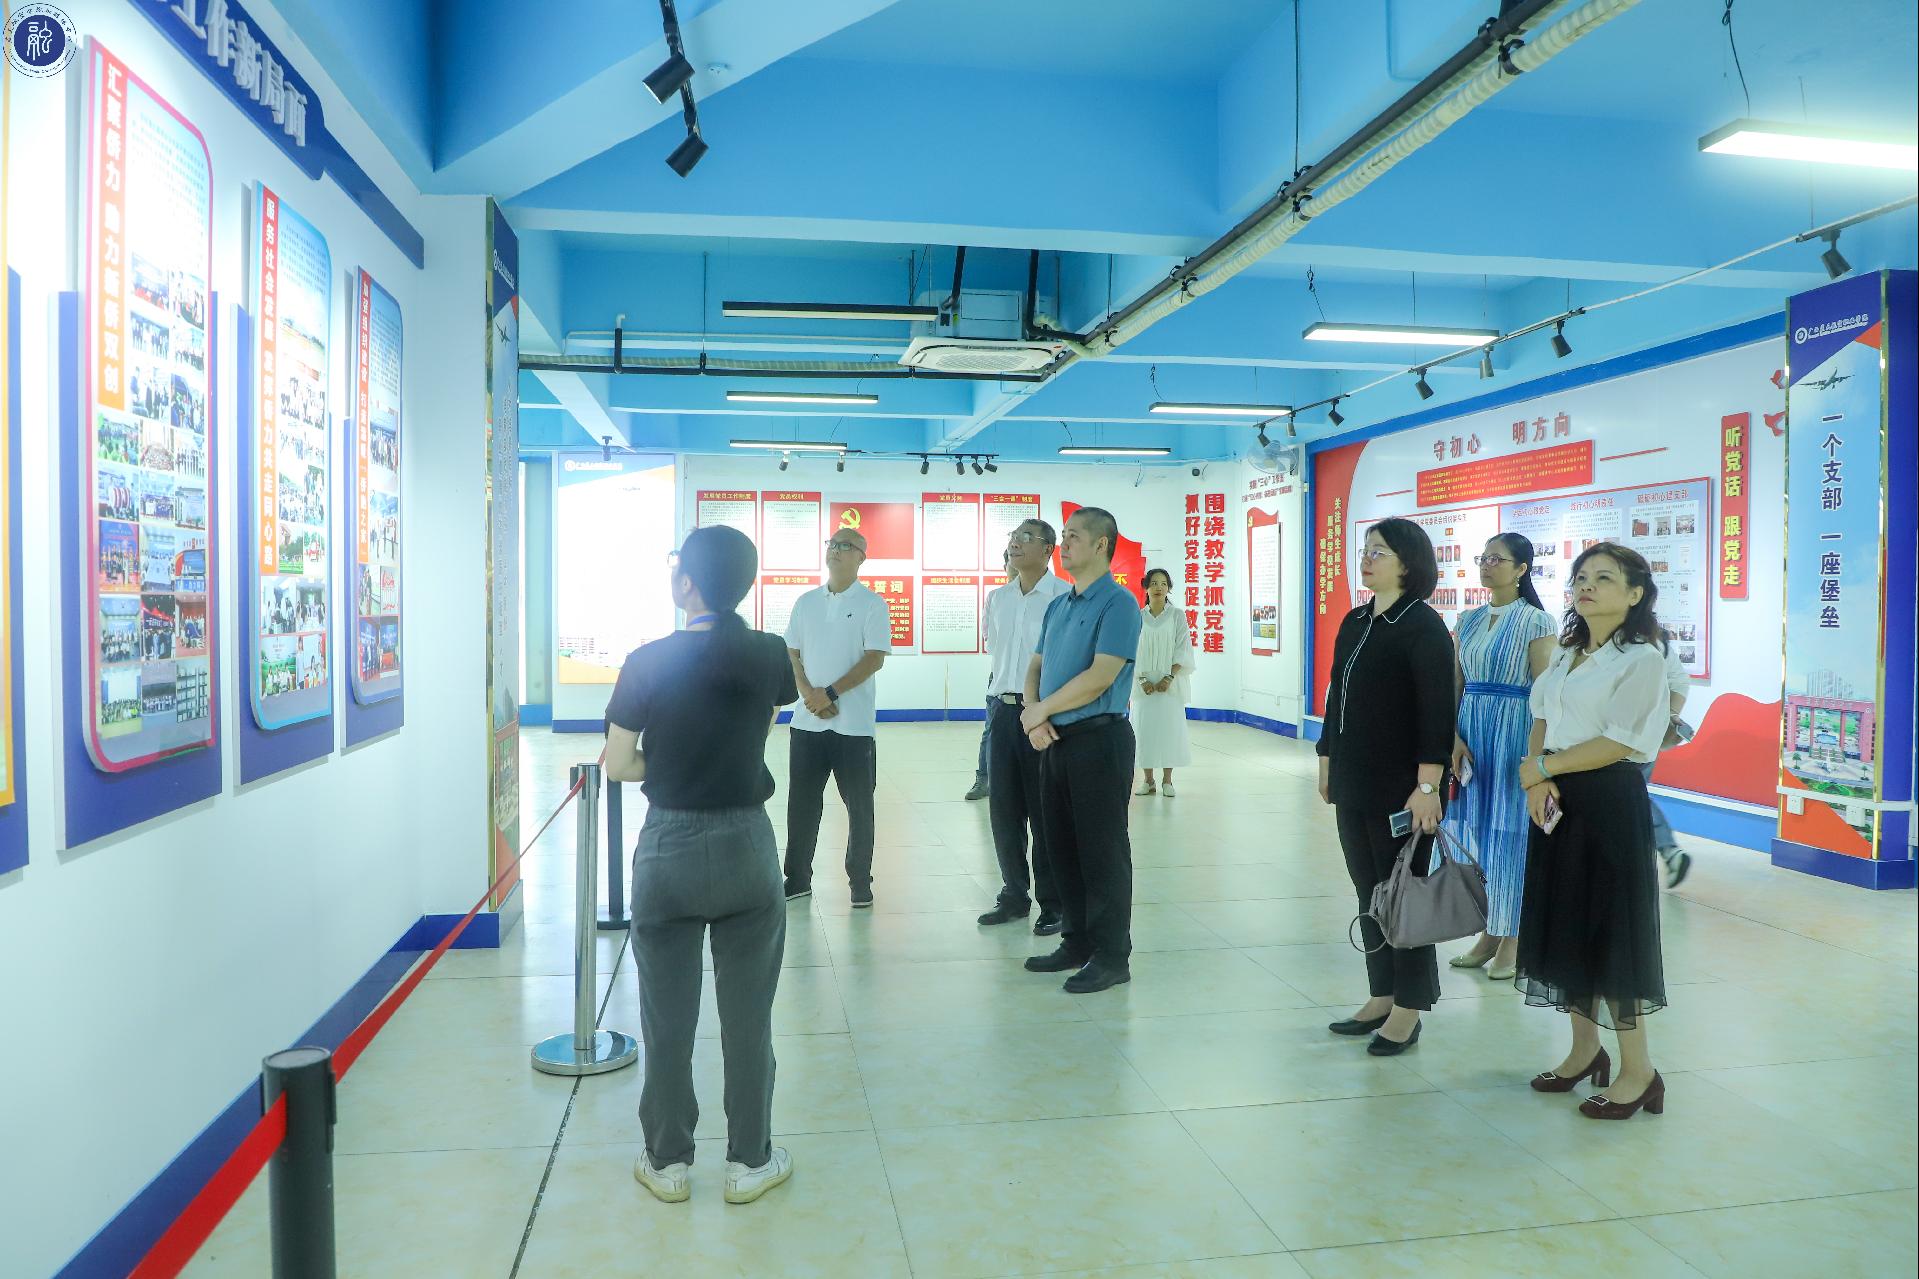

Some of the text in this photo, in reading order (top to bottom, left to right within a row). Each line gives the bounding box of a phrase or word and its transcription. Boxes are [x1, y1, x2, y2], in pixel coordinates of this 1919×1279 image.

[1433, 411, 1571, 461] 守初心 明方向
[1723, 426, 1743, 586] 听党话 跟党走
[1203, 493, 1225, 653] 围绕教学抓党建
[1819, 414, 1843, 628] 一个支部 一座堡垒
